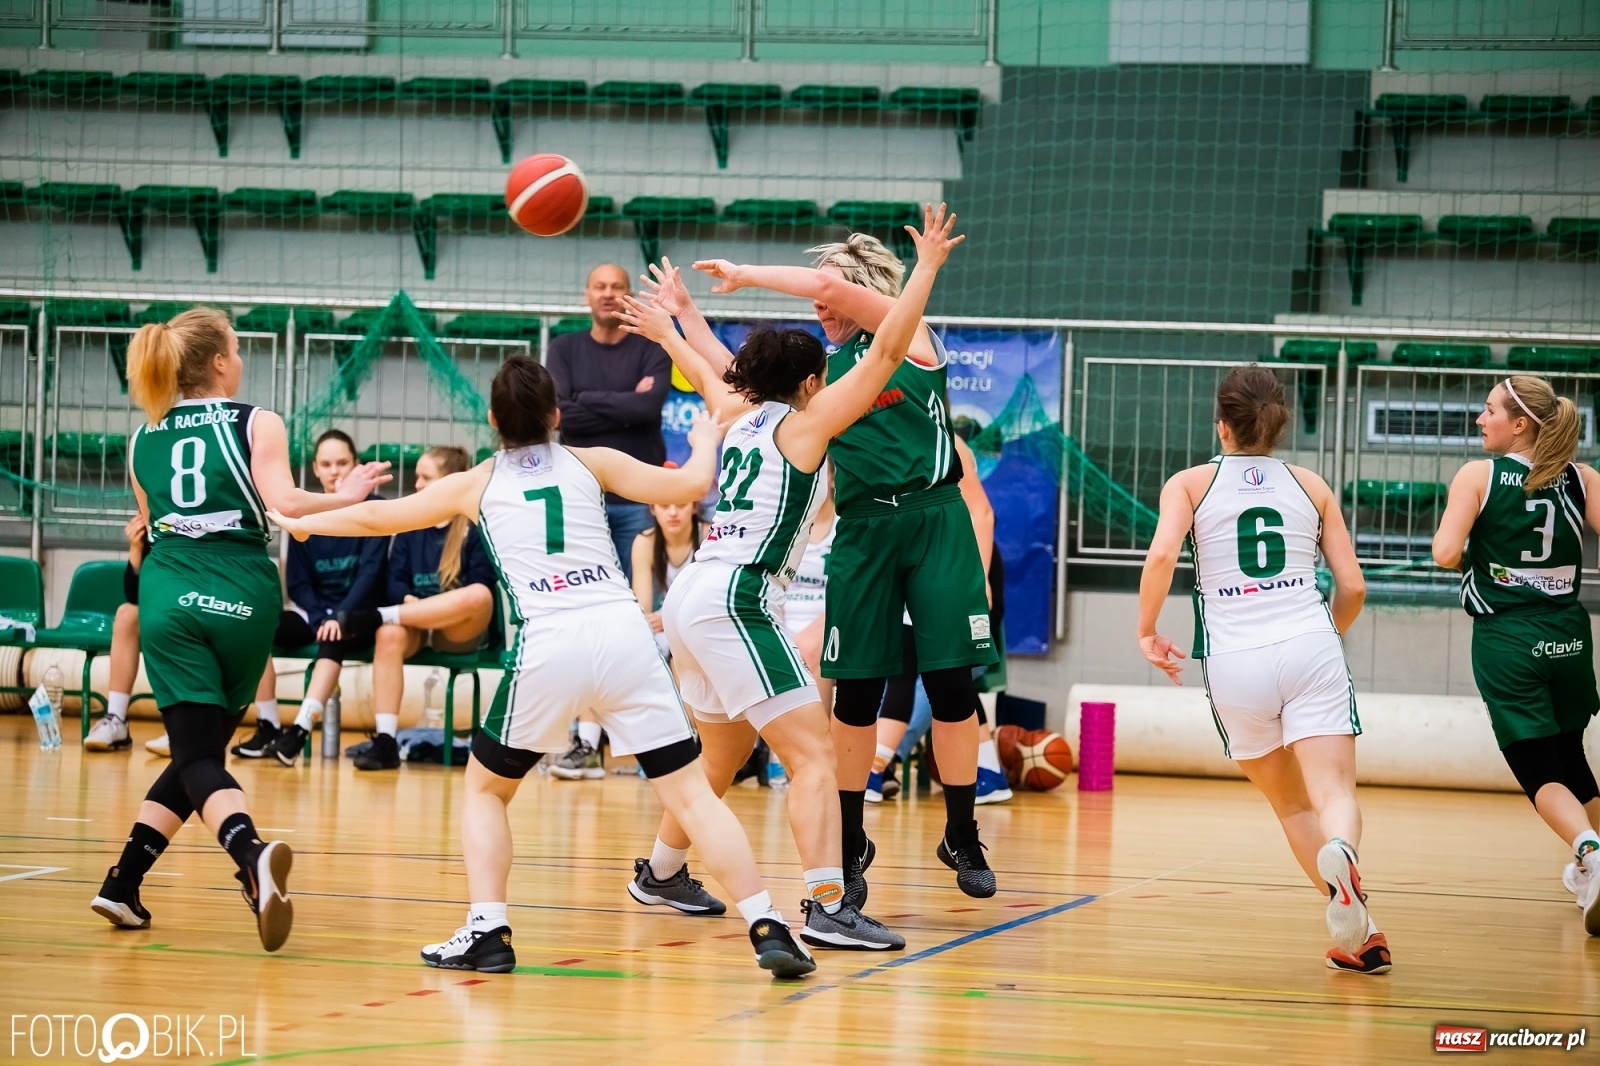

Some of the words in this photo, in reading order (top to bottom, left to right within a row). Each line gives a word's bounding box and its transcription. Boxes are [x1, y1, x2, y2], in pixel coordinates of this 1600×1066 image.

[947, 349, 994, 370] eacji
[170, 436, 207, 508] 8
[716, 446, 763, 512] 22
[1500, 471, 1523, 487] RKK
[523, 485, 564, 555] 7
[1237, 506, 1286, 579] 6
[1520, 499, 1556, 562] 3
[197, 595, 253, 617] Clavis
[1545, 638, 1583, 655] Clavis
